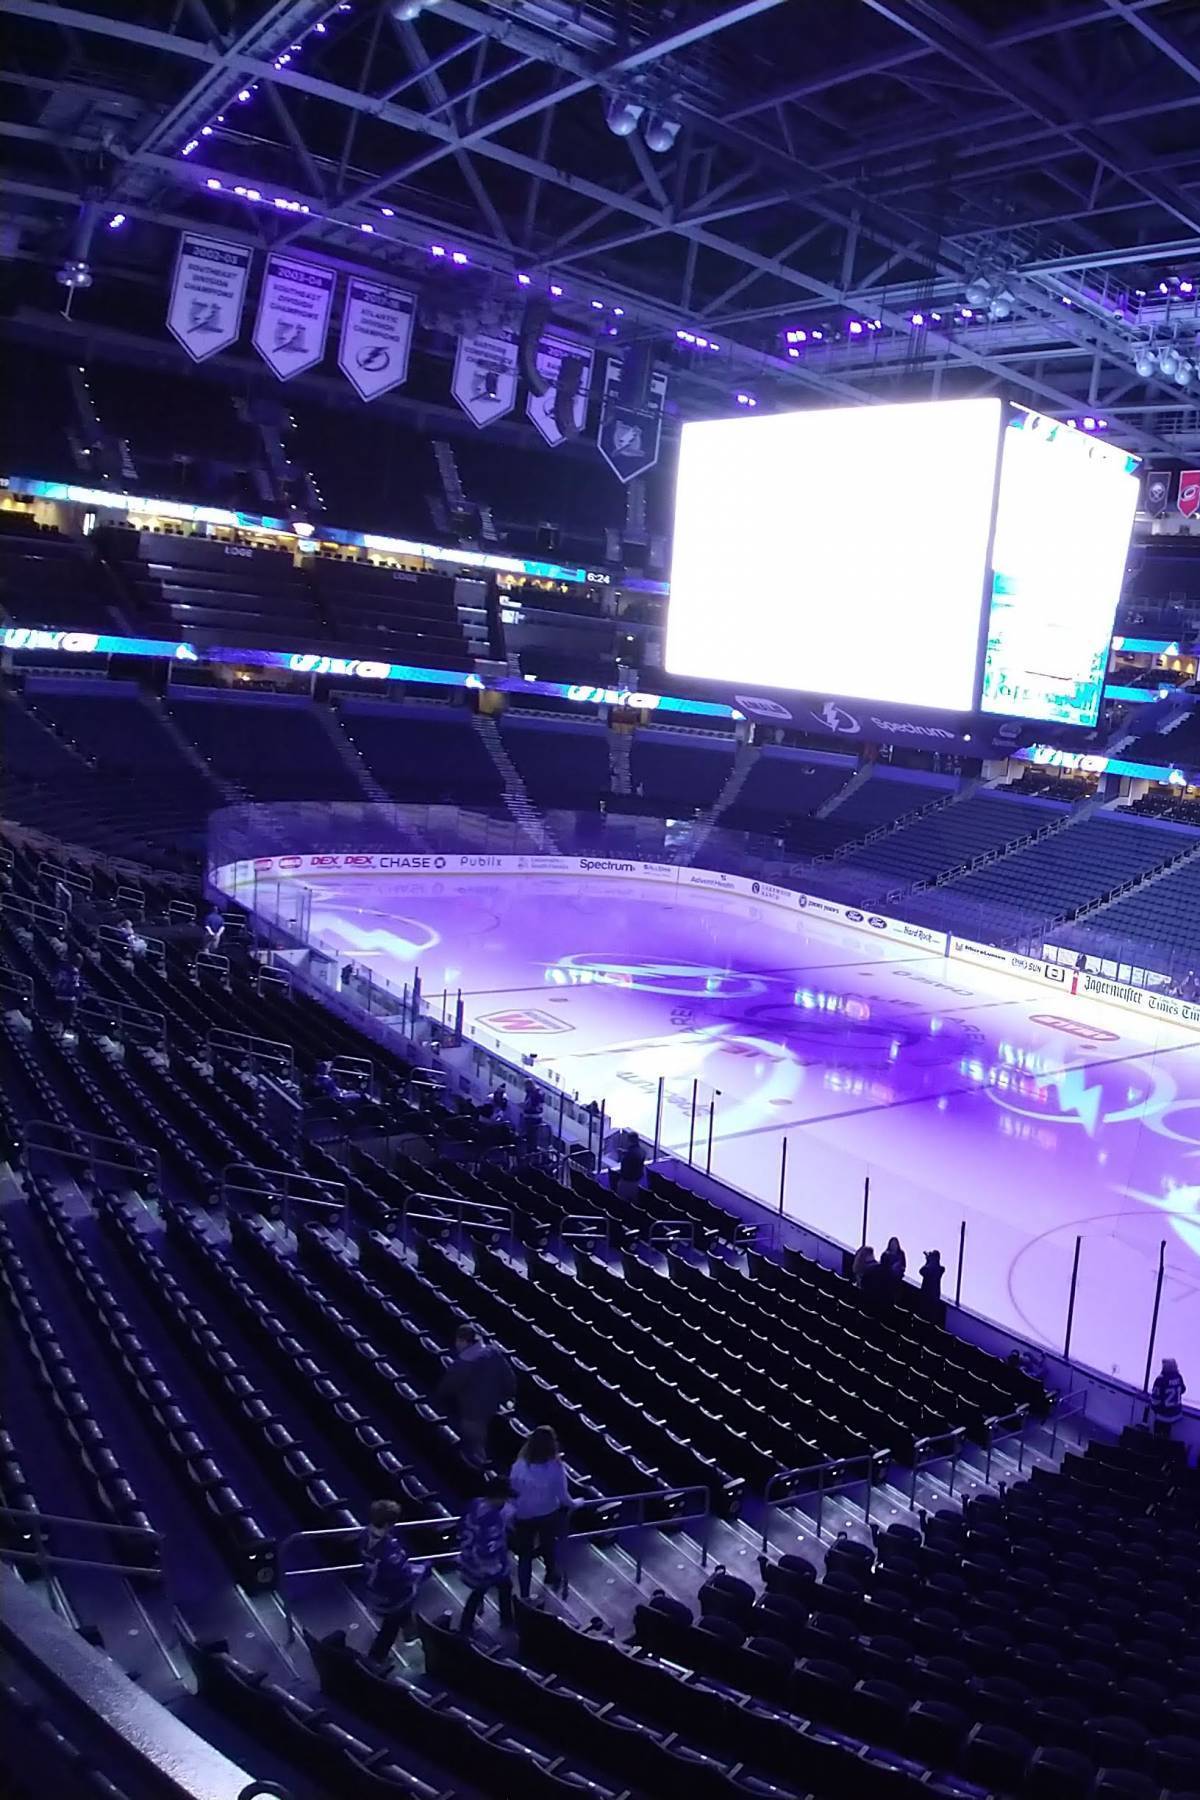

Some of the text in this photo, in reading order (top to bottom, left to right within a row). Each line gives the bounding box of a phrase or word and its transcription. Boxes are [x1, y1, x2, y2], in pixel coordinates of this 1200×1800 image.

[586, 572, 611, 585] 6:24
[310, 856, 341, 866] DEX
[343, 855, 375, 865] DEX
[380, 857, 431, 868] CHASE
[579, 858, 633, 872] Spectrum
[1148, 995, 1180, 1016] Times
